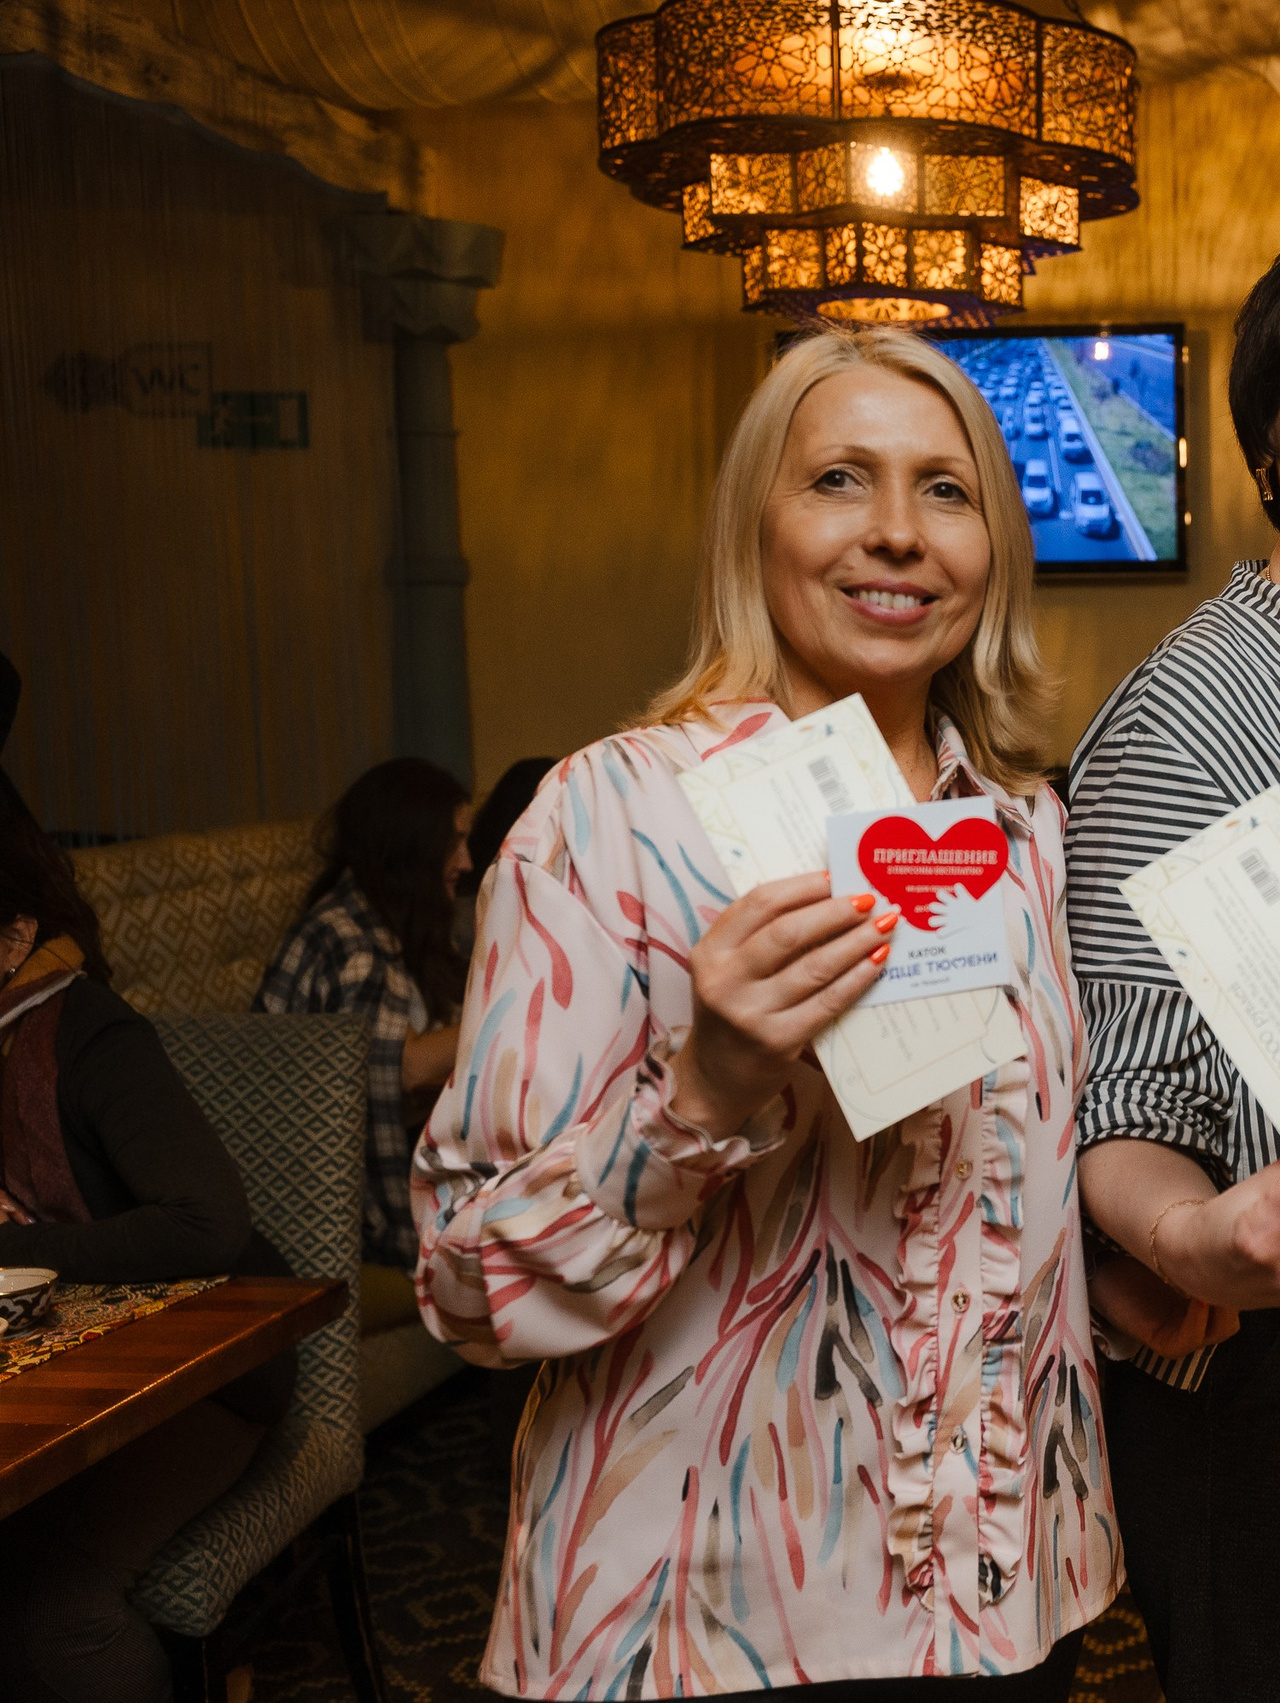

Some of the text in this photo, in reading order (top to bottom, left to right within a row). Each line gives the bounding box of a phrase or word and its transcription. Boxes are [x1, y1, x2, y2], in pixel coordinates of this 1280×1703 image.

[873, 848, 998, 865] ПРИГЛАШЕНИЕ
[908, 946, 947, 960] КАТОК
[879, 964, 920, 981] РДЦЕ
